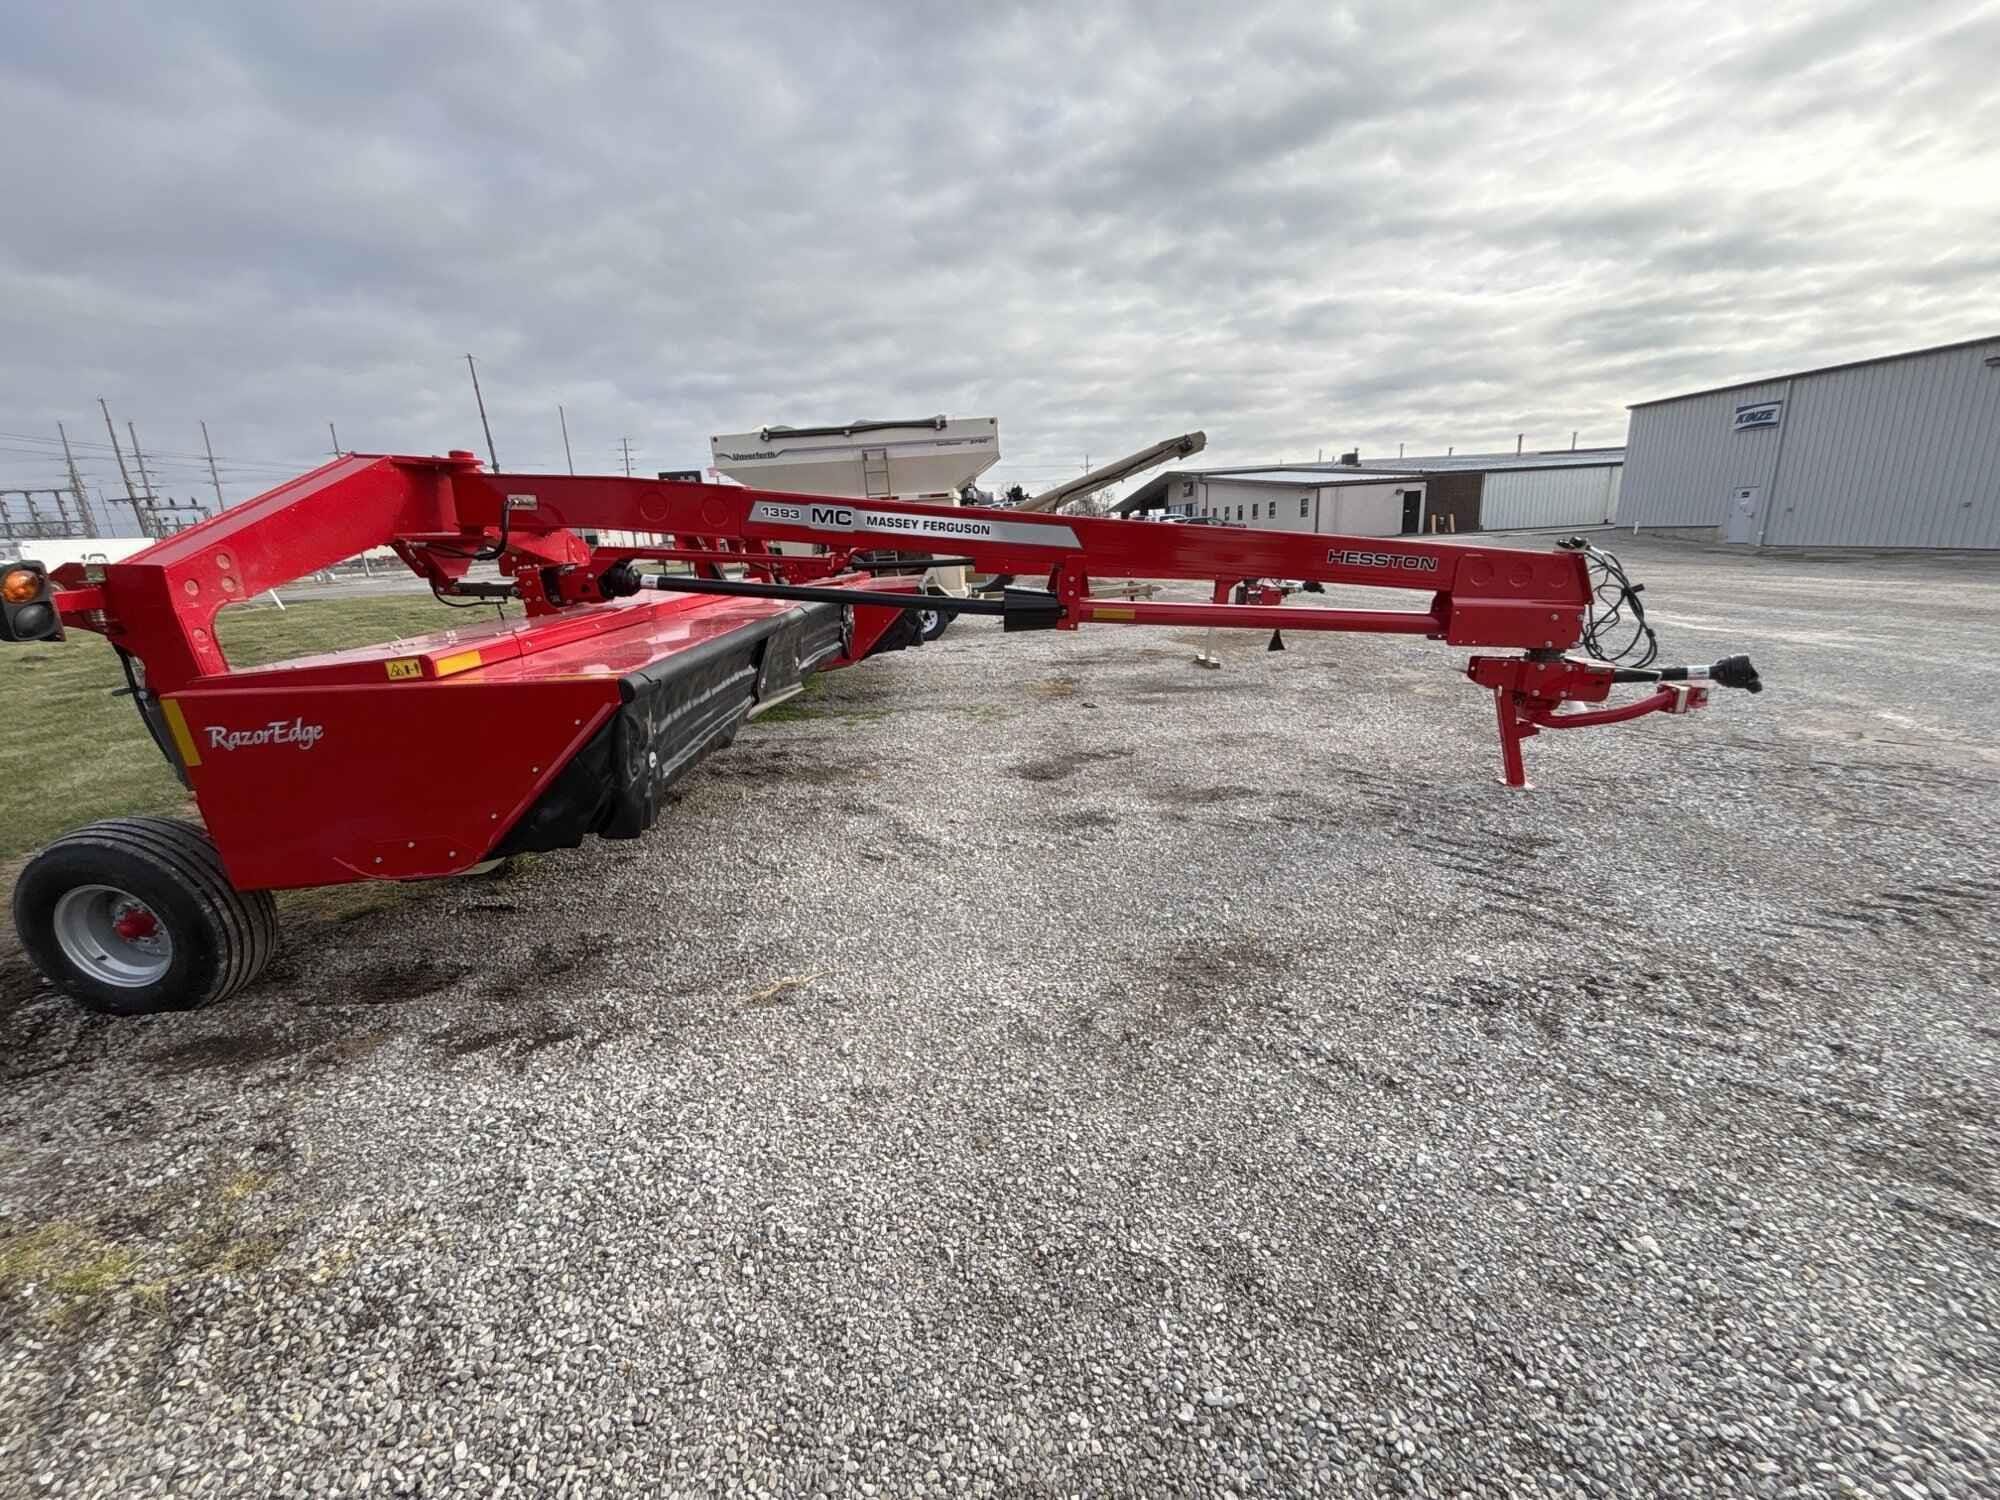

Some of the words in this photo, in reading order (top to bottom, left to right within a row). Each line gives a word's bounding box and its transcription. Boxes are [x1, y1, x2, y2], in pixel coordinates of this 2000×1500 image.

[1736, 409, 1777, 424] KINZE
[761, 507, 800, 519] 1393
[812, 508, 852, 526] MC
[866, 516, 919, 530] MASSEY
[923, 520, 991, 536] FERGUSON
[1327, 548, 1439, 572] HESSTON
[203, 716, 324, 751] RazorEdge
